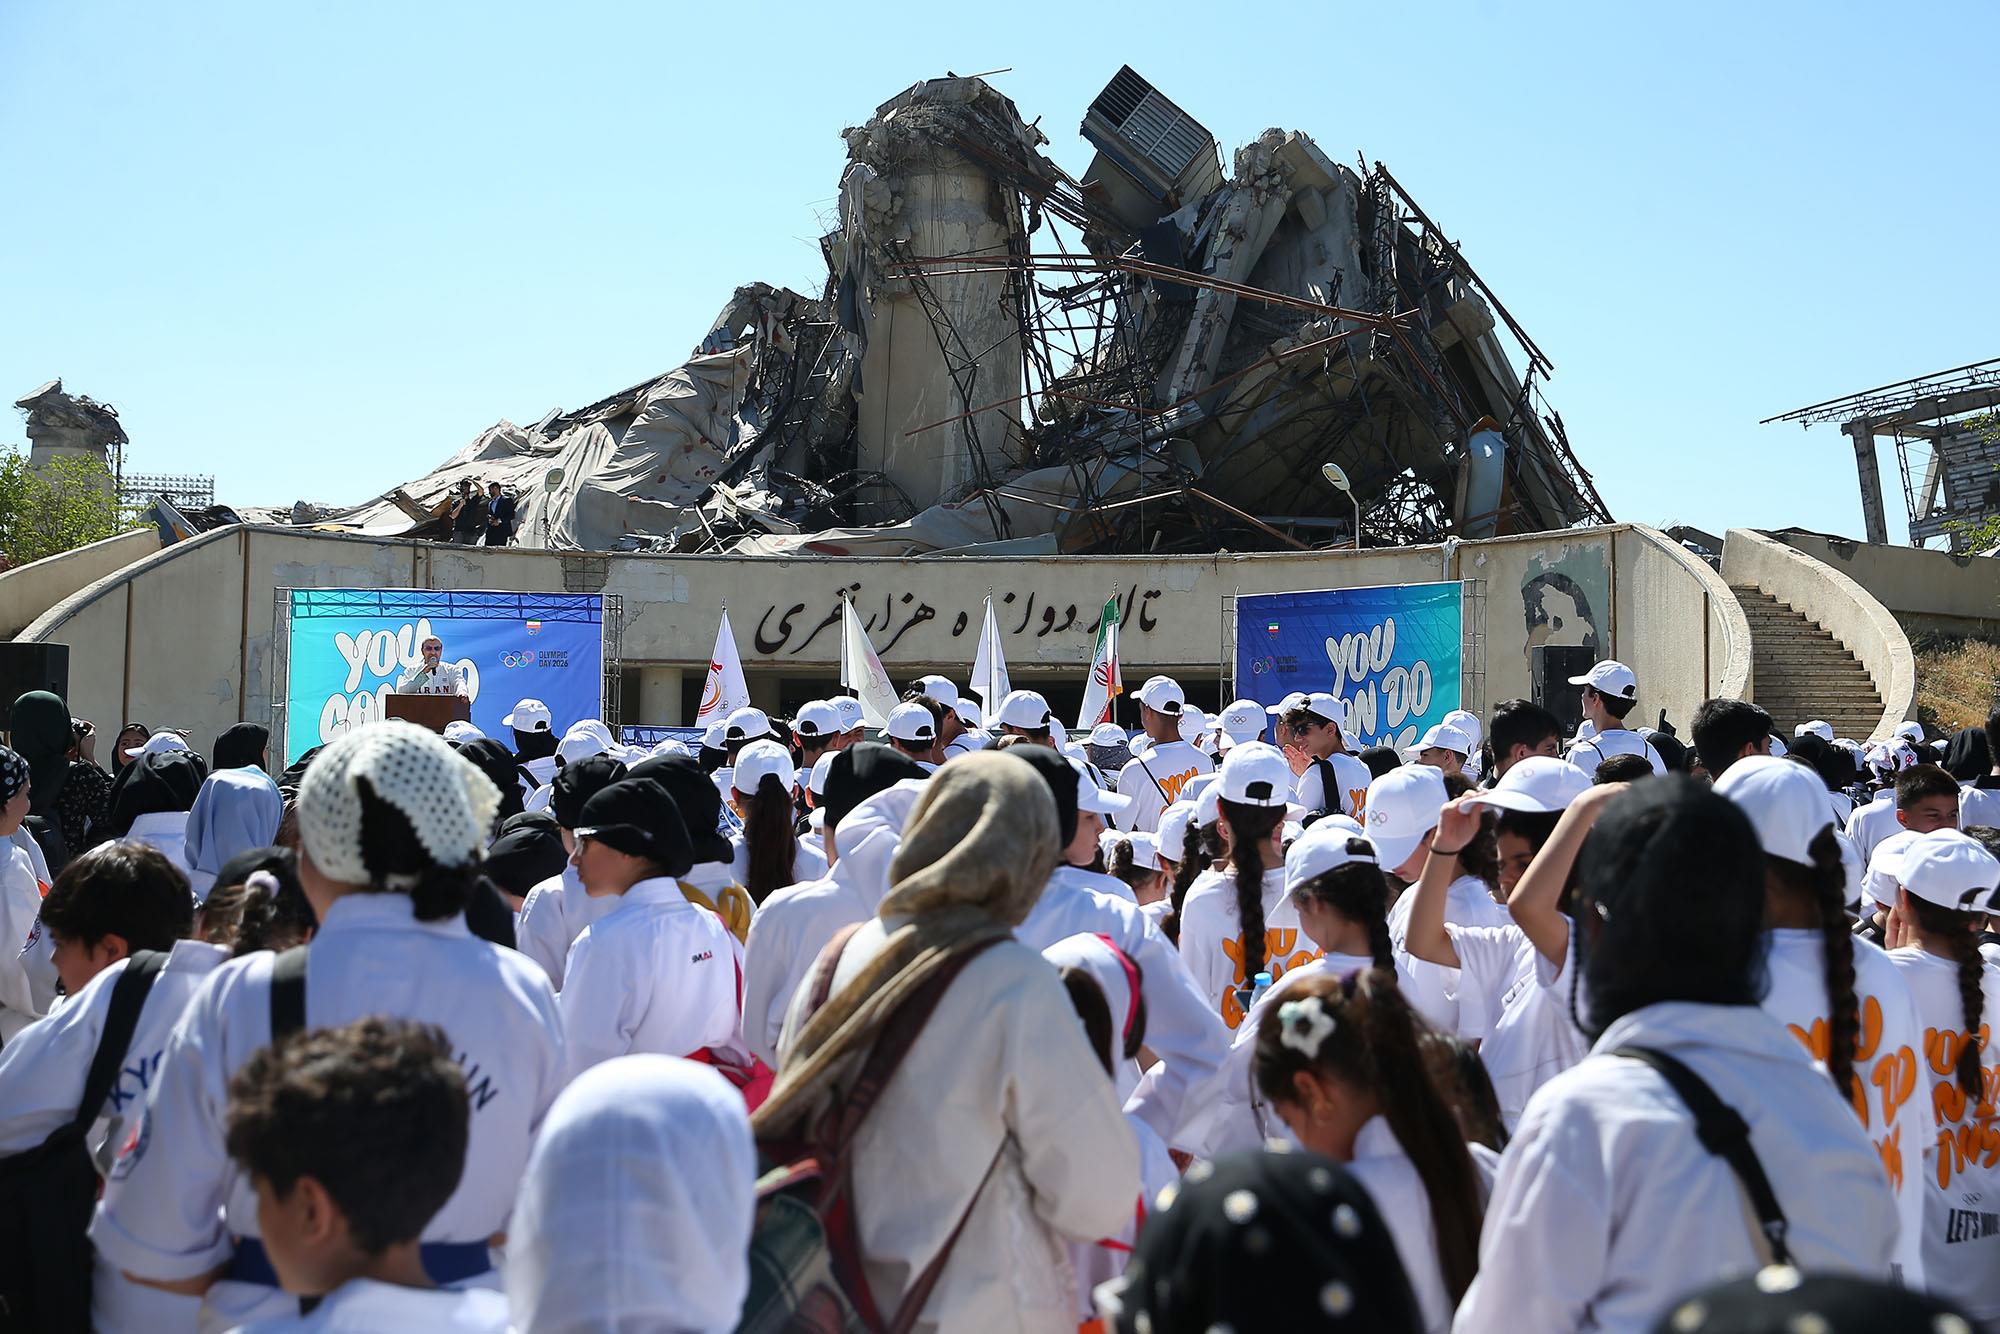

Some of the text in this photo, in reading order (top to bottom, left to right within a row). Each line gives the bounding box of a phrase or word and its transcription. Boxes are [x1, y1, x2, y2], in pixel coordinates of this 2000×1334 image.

[334, 617, 432, 694] YOU
[538, 650, 568, 659] OLYMPIC
[538, 660, 569, 668] DAY 2026
[1325, 616, 1396, 699] YOU
[1341, 659, 1433, 738] AN DO
[1946, 1207, 1979, 1244] LET'S
